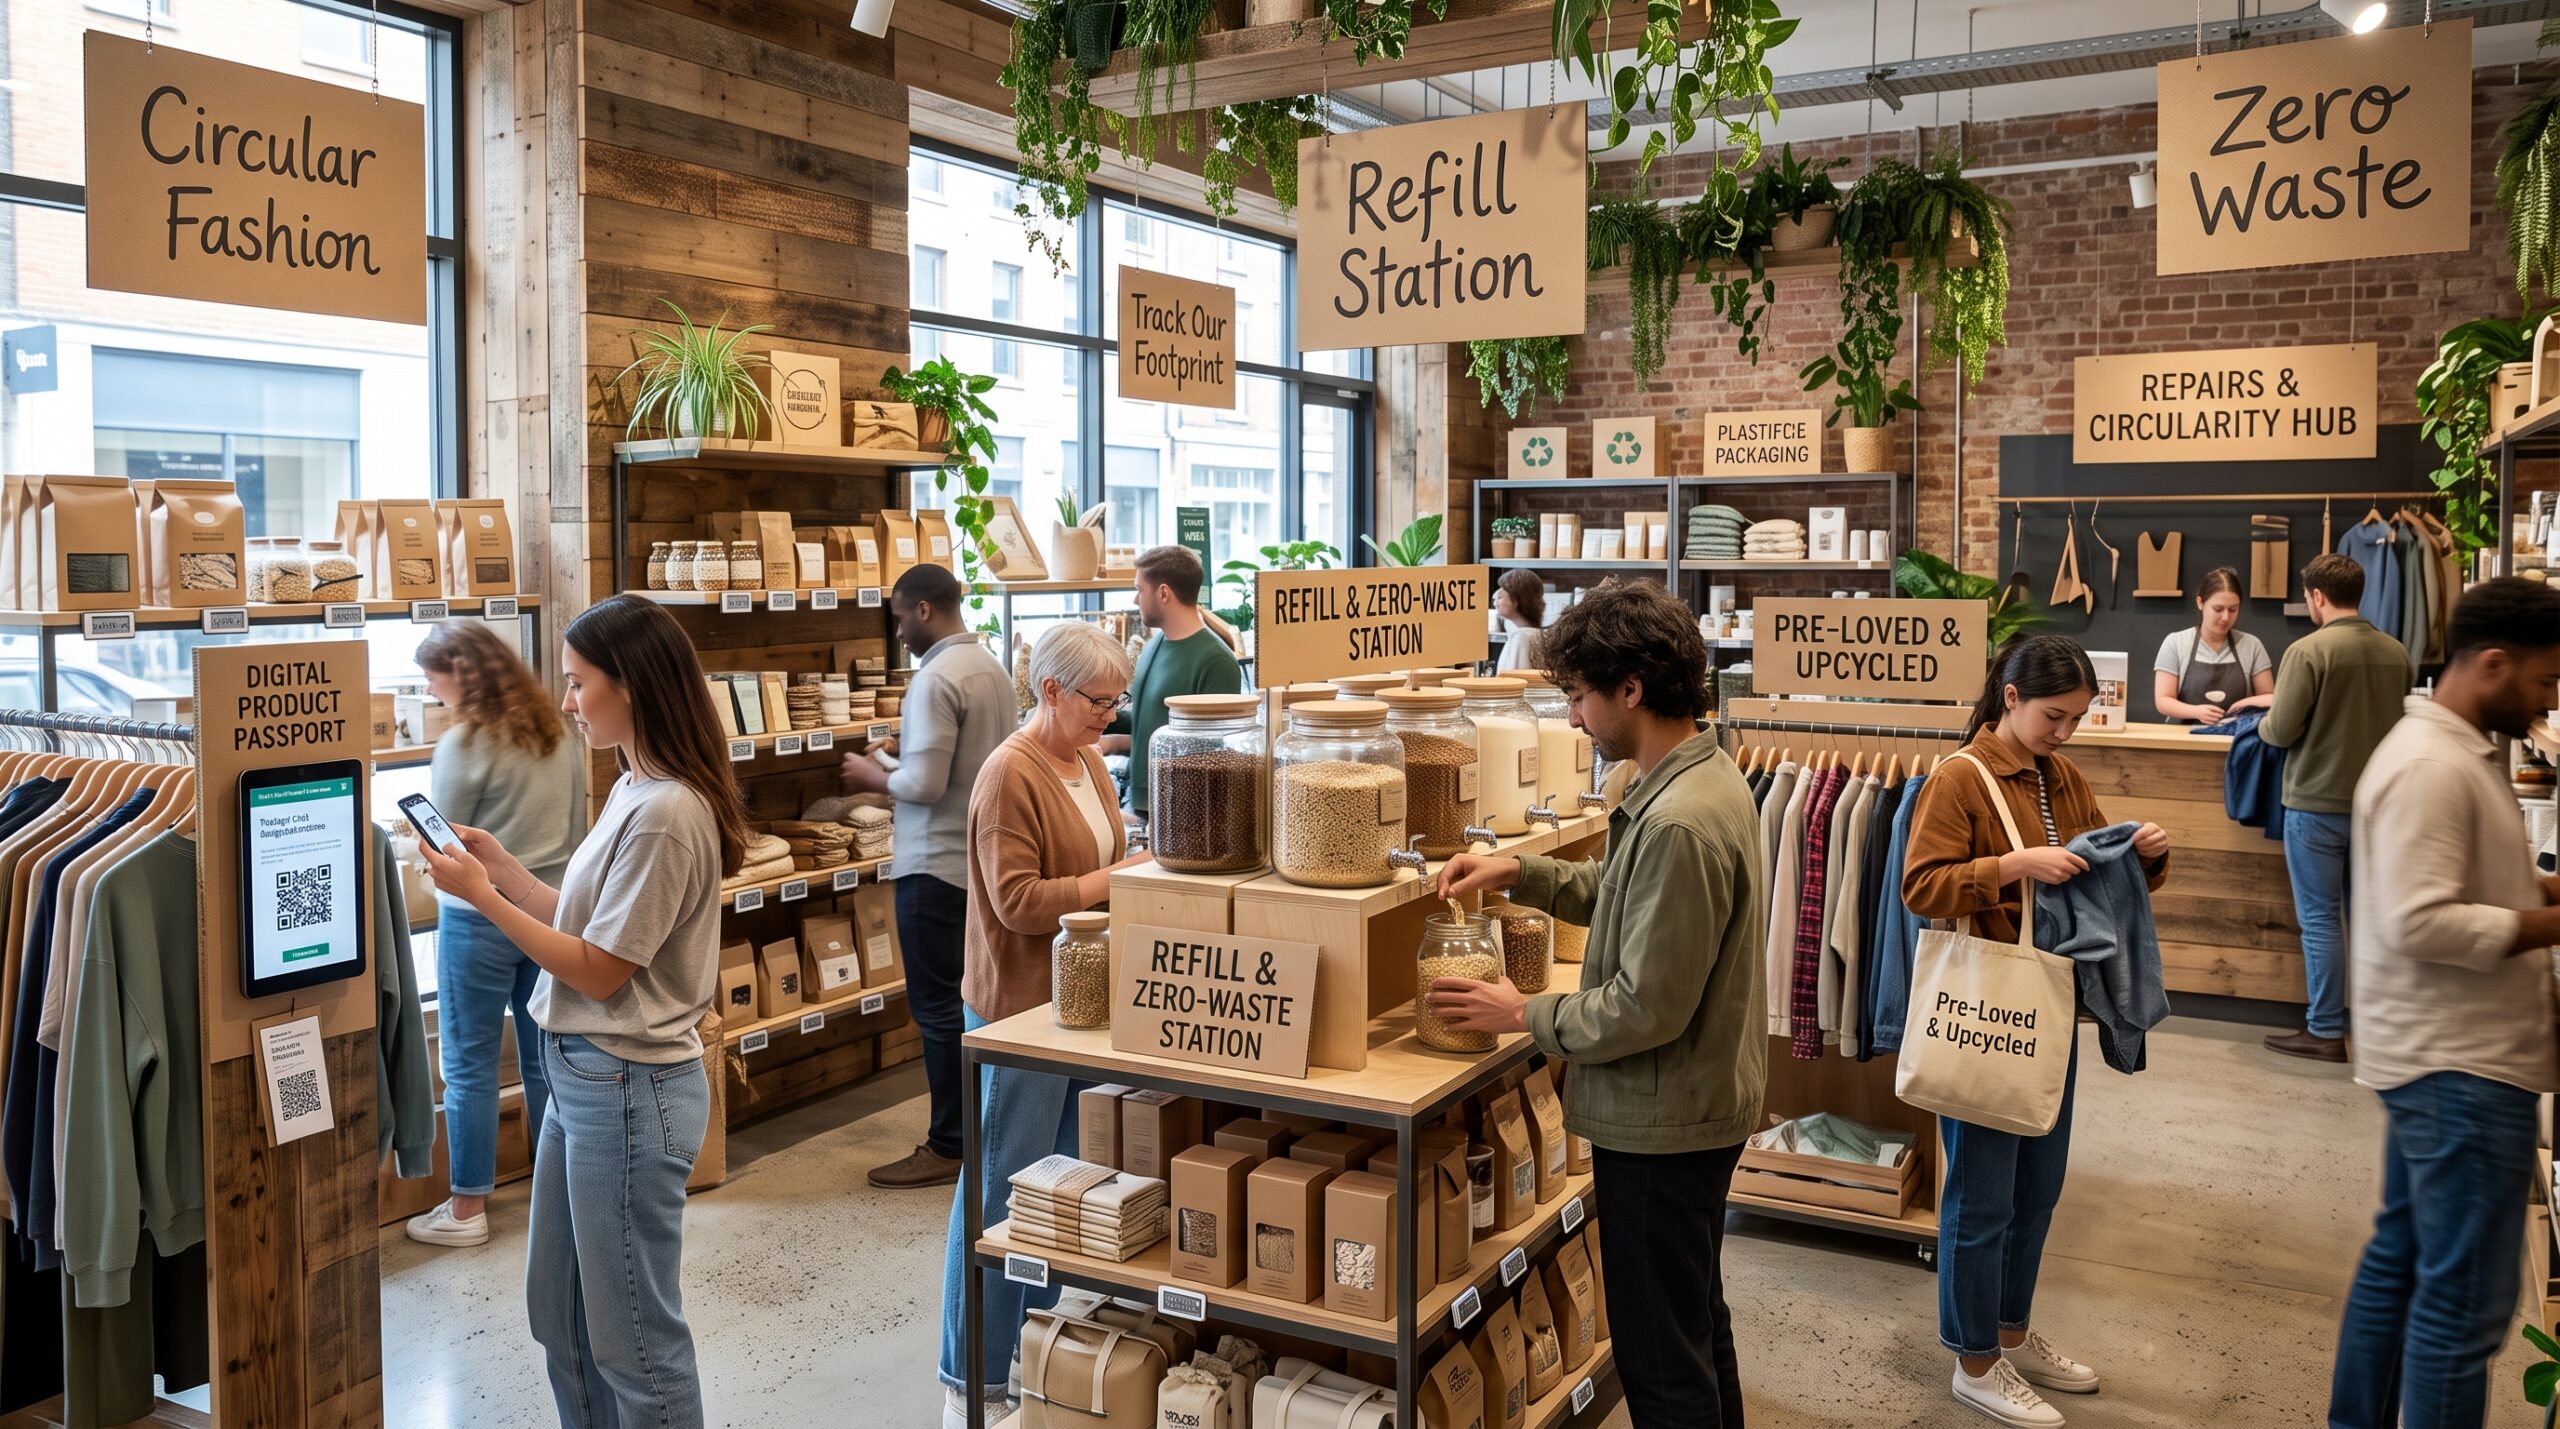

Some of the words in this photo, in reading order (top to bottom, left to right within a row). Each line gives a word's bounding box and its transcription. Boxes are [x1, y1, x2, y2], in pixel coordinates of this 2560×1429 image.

[140, 85, 377, 189] Circular
[2209, 84, 2411, 157] Zero
[1348, 139, 1517, 243] Refill
[2190, 144, 2432, 236] Waste
[166, 185, 381, 276] Fashion
[1334, 239, 1544, 319] Station
[1130, 292, 1187, 336] Track
[1191, 304, 1227, 341] Our
[1135, 339, 1224, 392] Footprint
[2142, 369, 2265, 402] REPAIRS
[2276, 367, 2300, 398] &
[2089, 408, 2281, 442] CIRCULARITY
[2293, 406, 2357, 437] HUB
[1716, 445, 1809, 464] PACKAGING
[1275, 586, 1341, 625] REFILL
[1346, 584, 1361, 620] &
[1366, 579, 1476, 617] ZERO-WASTE
[1349, 622, 1423, 661] STATION
[1775, 614, 1929, 646] PRE-LOVED
[1940, 617, 1961, 647] &
[247, 661, 332, 689] DIGITAL
[1796, 650, 1938, 683] UPCYCLED
[238, 690, 342, 720] PRODUCT
[234, 719, 346, 751] PASSPORT
[1151, 940, 1246, 983] REFILL
[1255, 951, 1277, 986] &
[1132, 979, 1294, 1027] ZERO-WASTE
[1936, 991, 2037, 1030] Pre-Loved
[1159, 1019, 1262, 1061] STATION
[1926, 1017, 1940, 1039] &
[1946, 1021, 2037, 1058] Upcycled
